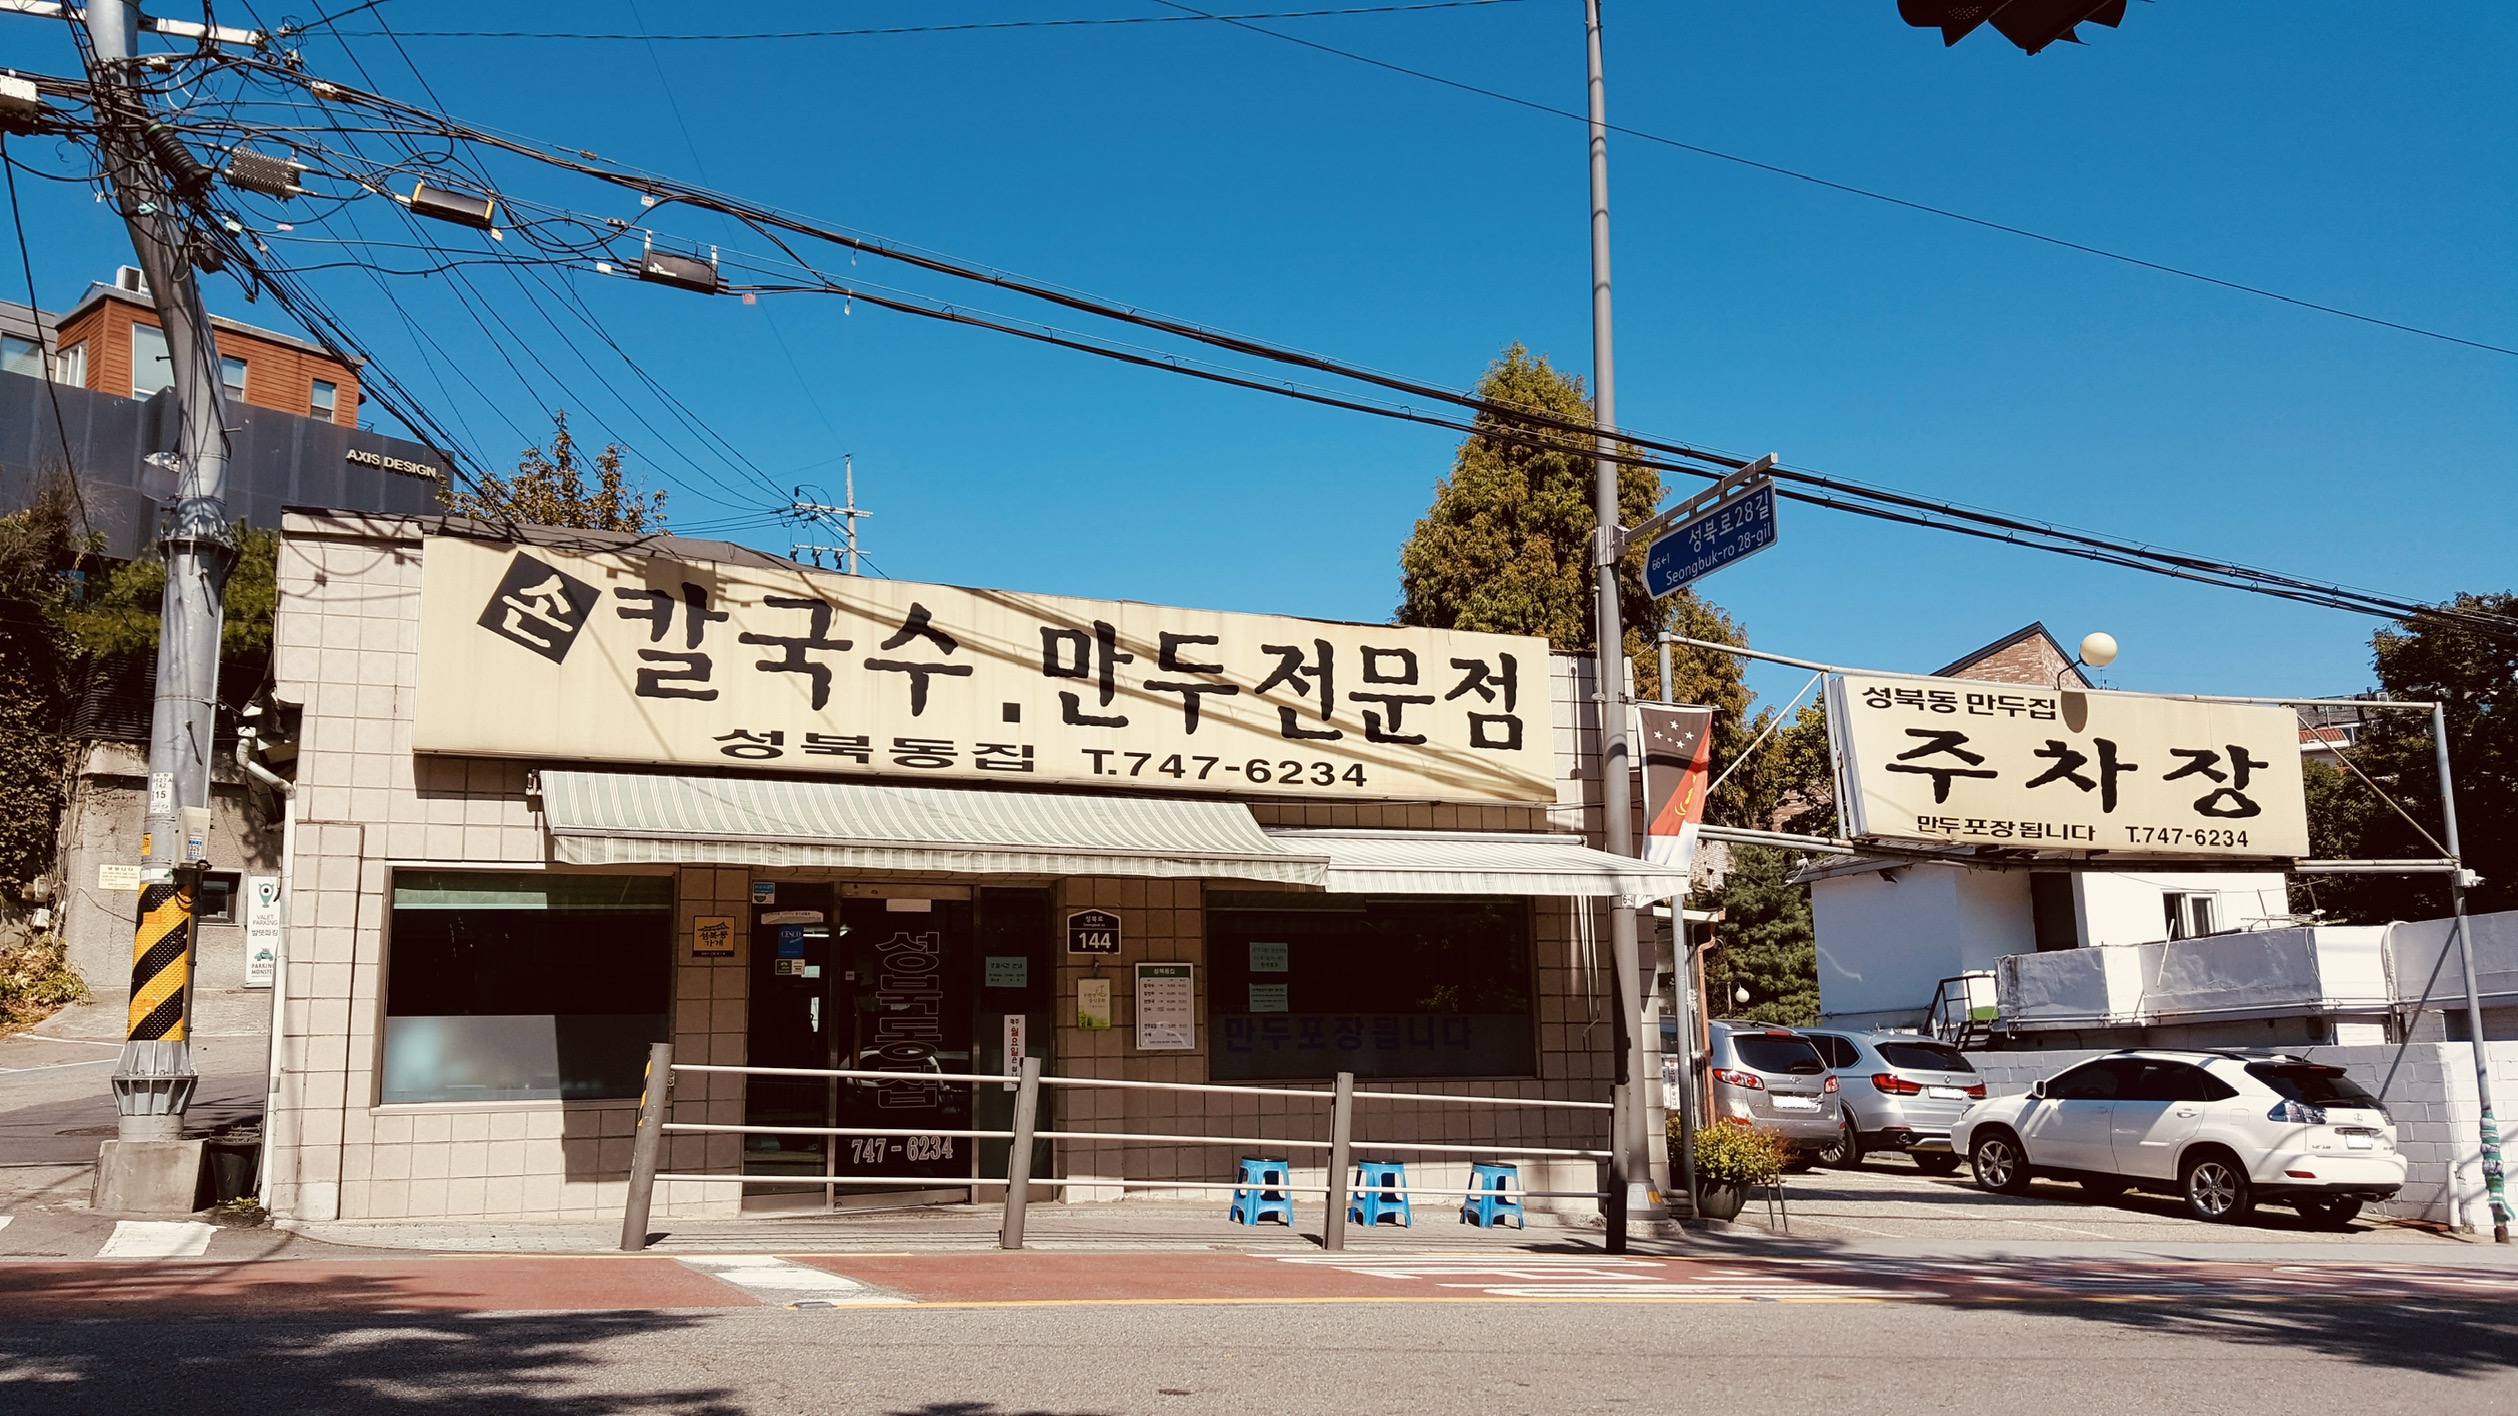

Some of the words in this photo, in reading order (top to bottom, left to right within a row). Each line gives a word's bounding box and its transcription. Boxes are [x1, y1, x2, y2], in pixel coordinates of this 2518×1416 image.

[345, 449, 380, 465] AXIS
[383, 456, 437, 478] DESIGN
[1688, 490, 1770, 553] 성북로28길
[1665, 545, 1735, 586] Seongbuk-ro
[1737, 522, 1771, 552] 28-gil
[502, 573, 574, 648] 손
[1861, 687, 1958, 714] 성북동
[1966, 693, 2057, 721] 만두집
[711, 729, 1034, 773] 성북동집
[1082, 748, 1367, 788] T.747-6234
[1885, 728, 2269, 818] 주차장
[155, 790, 166, 799] 15
[2125, 826, 2249, 848] T.747-6234
[1079, 932, 1112, 949] 144
